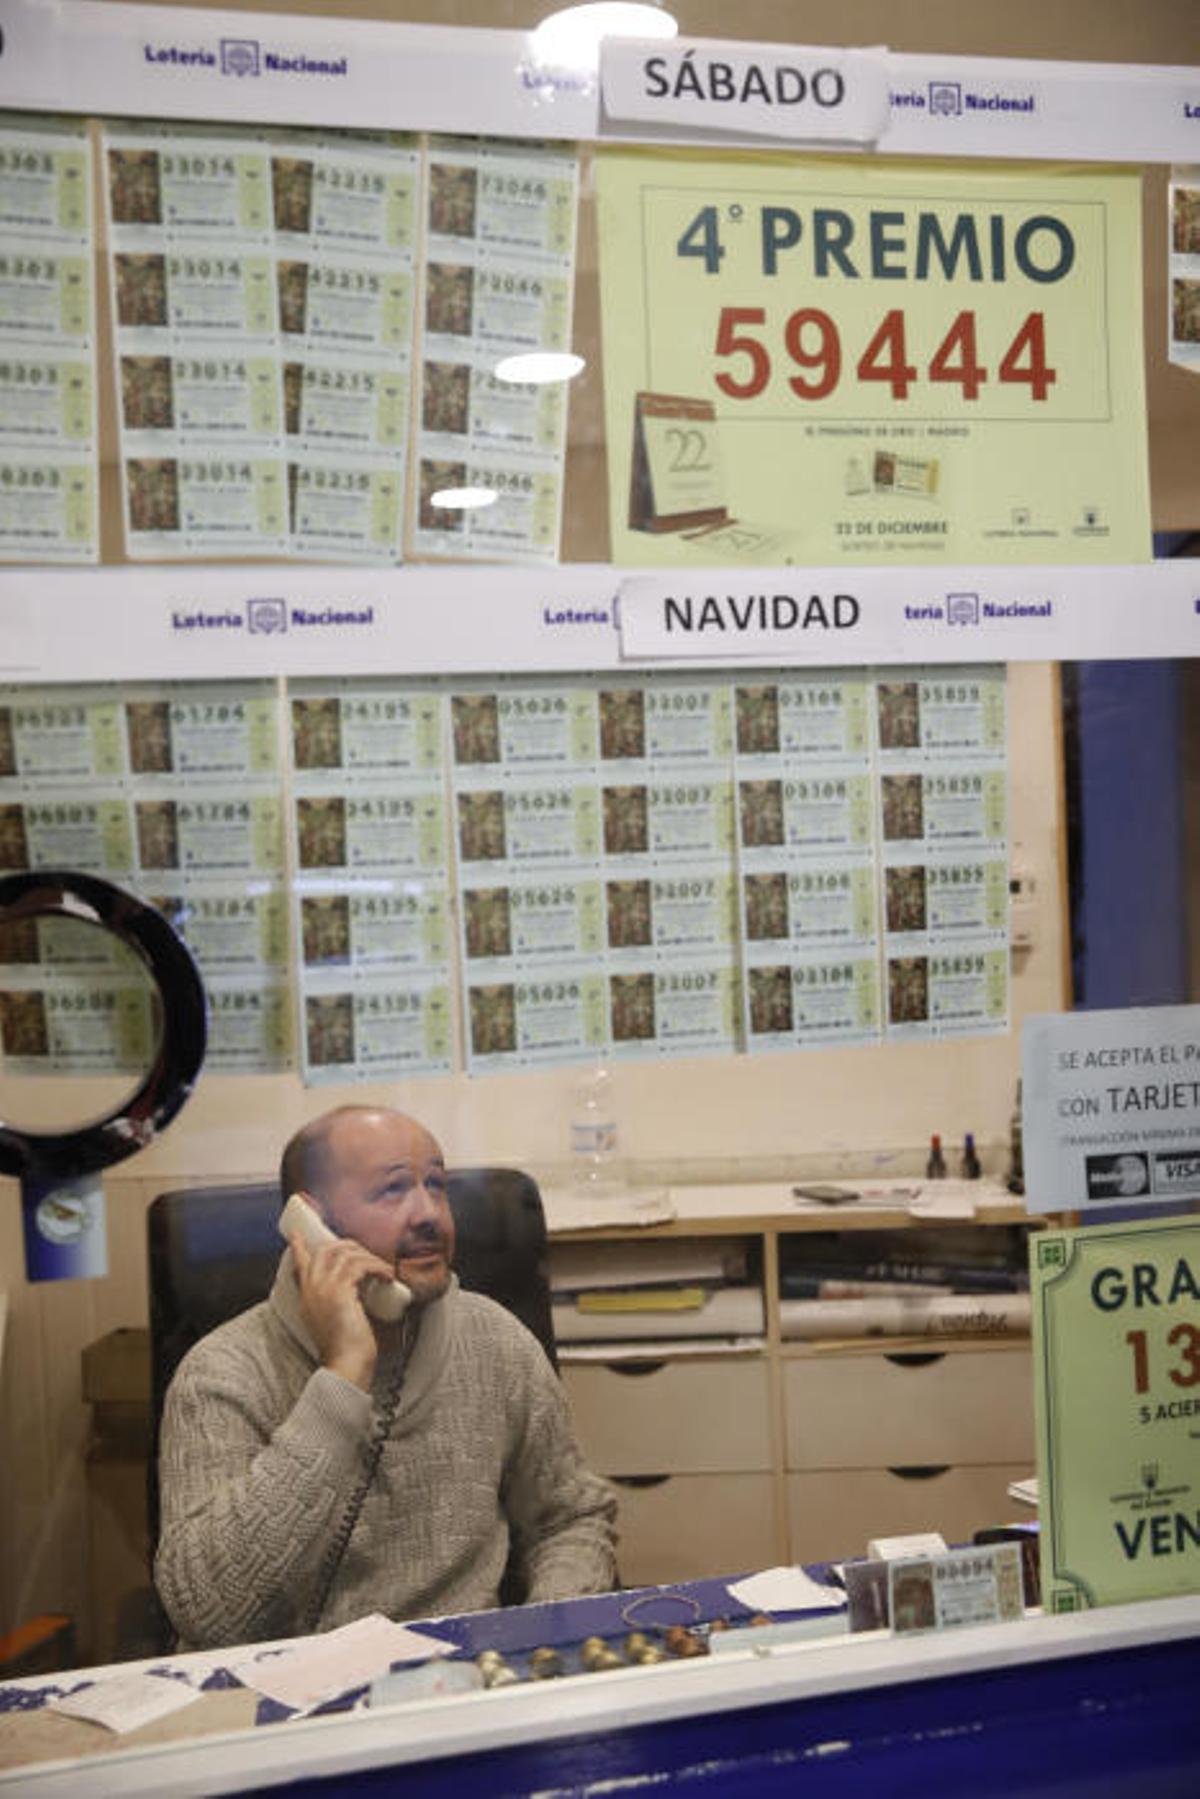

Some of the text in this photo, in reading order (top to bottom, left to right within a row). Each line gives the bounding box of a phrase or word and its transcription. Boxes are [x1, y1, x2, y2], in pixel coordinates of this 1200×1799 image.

[265, 54, 347, 76] Nacional
[644, 49, 846, 108] SÁBADO
[965, 94, 1035, 112] Nacional
[761, 206, 1076, 284] PREMIO
[713, 306, 1057, 402] 59444
[665, 428, 713, 473] 22
[856, 522, 872, 535] DE
[878, 520, 948, 534] DICIEMBRE
[291, 606, 373, 626] Nacional
[664, 593, 860, 632] NAVIDAD
[983, 601, 1051, 619] Nacional
[1059, 1052, 1080, 1069] SE
[1084, 1047, 1155, 1068] ACEPTA
[1161, 1046, 1180, 1063] EL
[1058, 1097, 1099, 1117] CON
[1092, 1257, 1200, 1312] GRA
[1114, 1511, 1200, 1561] VEN
